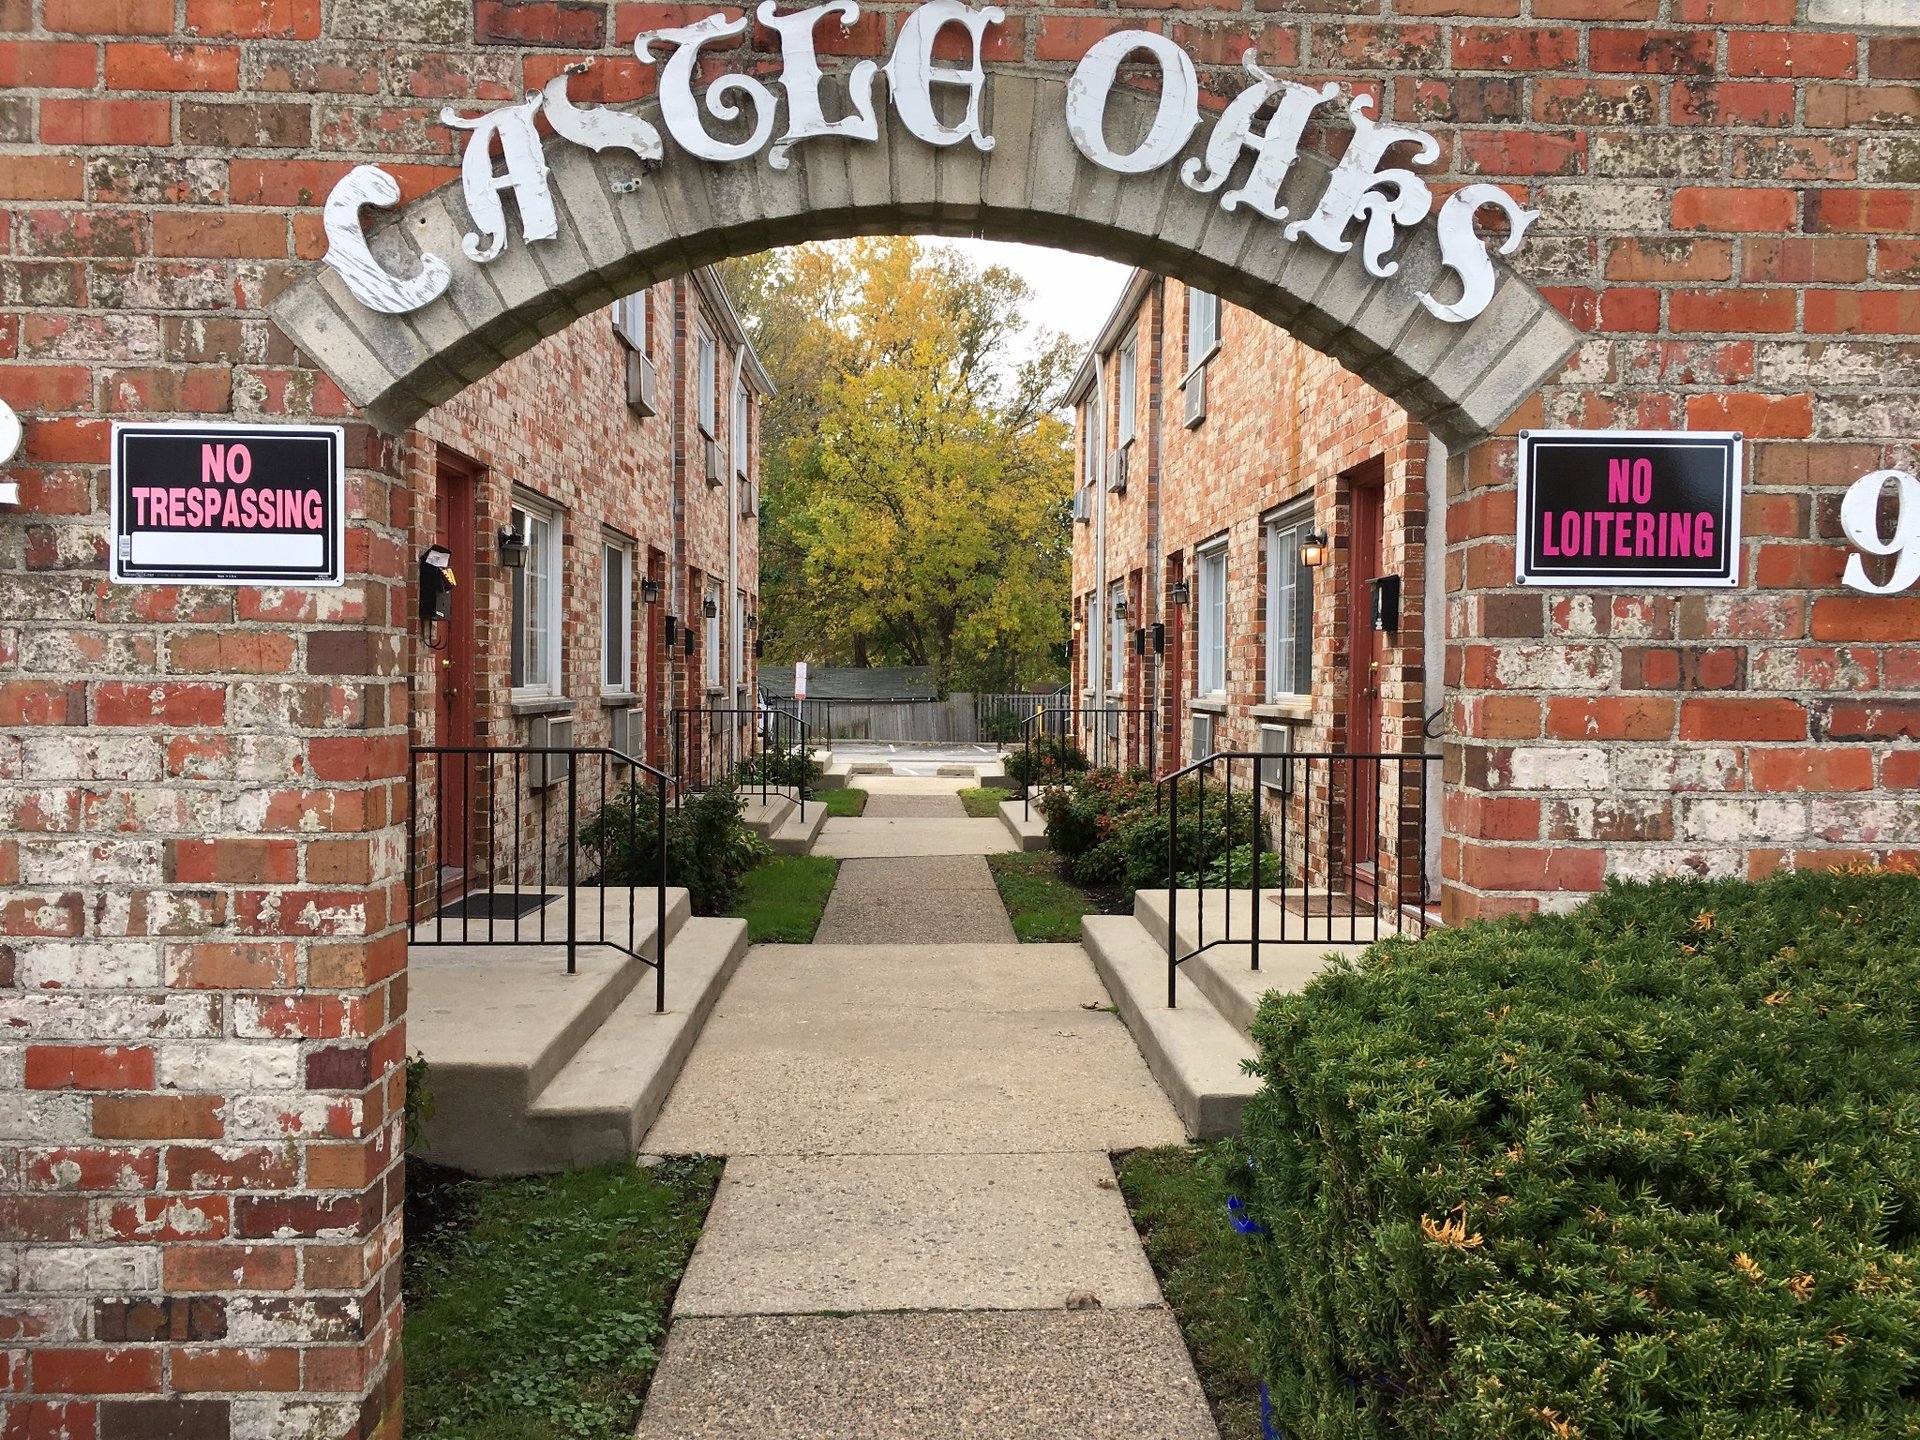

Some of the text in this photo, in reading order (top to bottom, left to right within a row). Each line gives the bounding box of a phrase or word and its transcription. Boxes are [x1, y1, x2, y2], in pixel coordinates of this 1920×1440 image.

[1065, 29, 1540, 324] OAKS
[201, 443, 252, 484] NO
[1607, 457, 1653, 504] NO
[131, 486, 323, 529] TRESPASSING
[1542, 510, 1715, 558] LOITERING
[1841, 469, 1920, 594] 9
